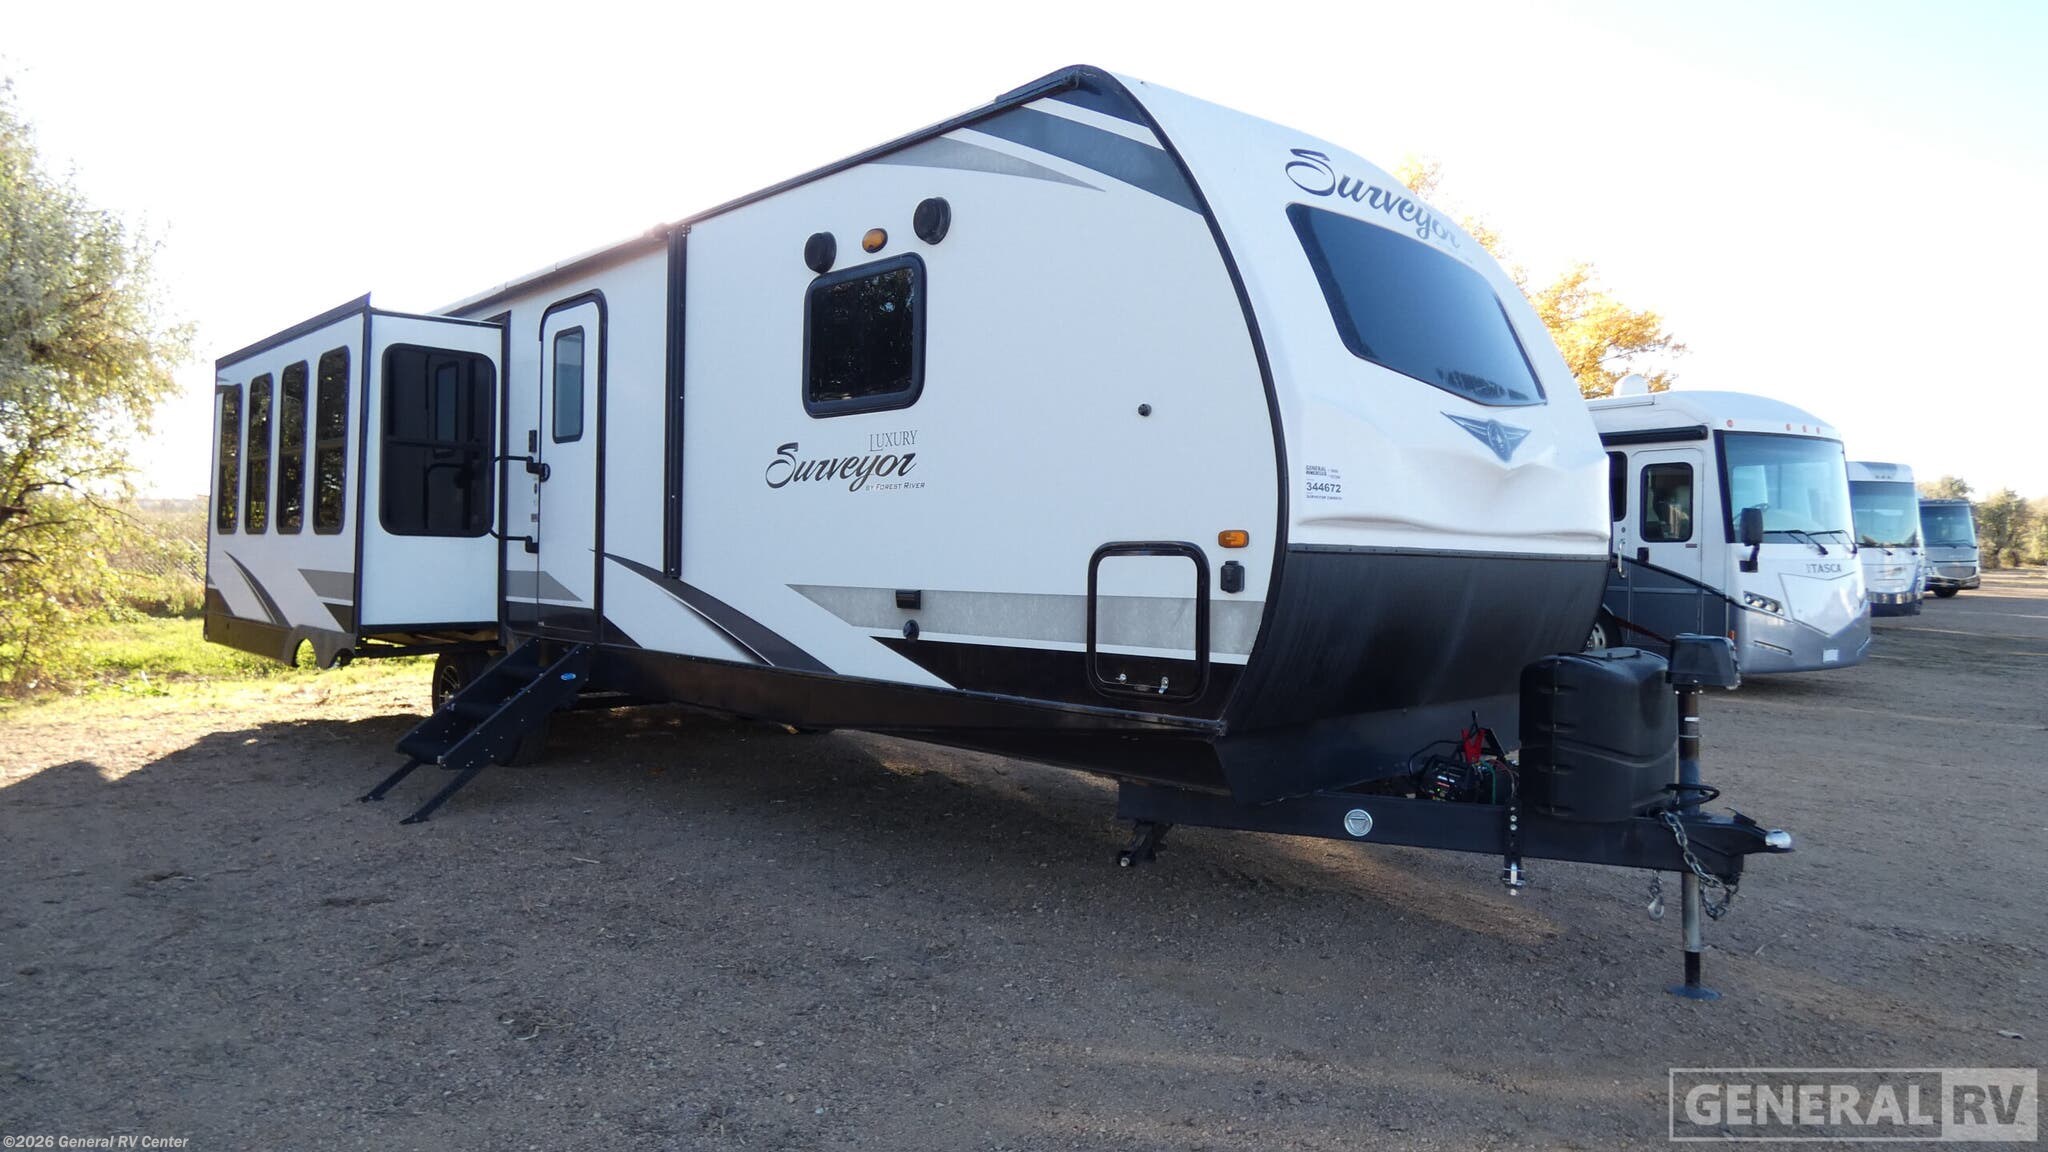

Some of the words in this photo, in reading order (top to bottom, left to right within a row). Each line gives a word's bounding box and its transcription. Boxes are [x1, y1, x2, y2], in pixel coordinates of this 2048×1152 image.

[1285, 148, 1460, 249] Surveyor
[869, 429, 918, 452] LUXURY
[765, 442, 917, 493] Surveyor
[875, 482, 902, 490] FOREST
[903, 481, 926, 489] RIVER
[1306, 481, 1342, 494] 344672
[1806, 563, 1842, 574] ITASCA
